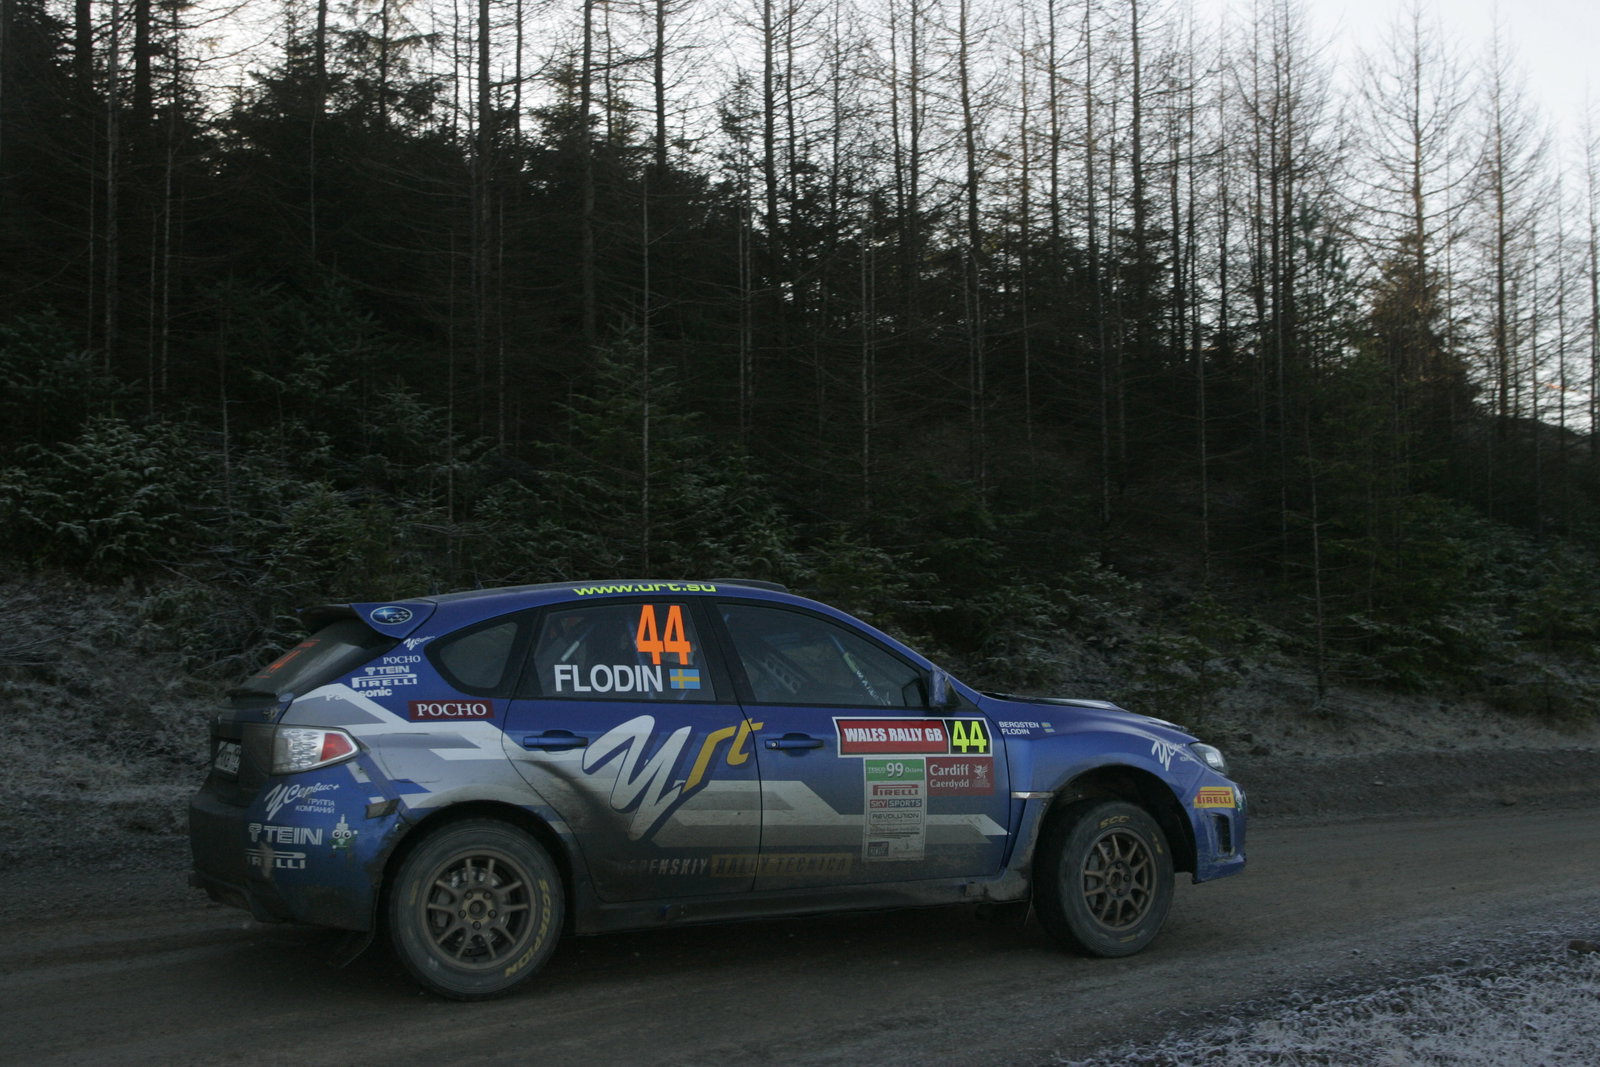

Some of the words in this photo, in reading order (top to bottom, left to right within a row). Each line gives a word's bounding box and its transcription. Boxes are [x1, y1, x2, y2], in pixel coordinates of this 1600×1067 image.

[573, 583, 718, 596] www.urt.su
[636, 604, 692, 666] 44
[352, 673, 418, 688] PIRELLI
[554, 664, 664, 692] FLODIN
[998, 721, 1040, 729] BERGSTEN
[844, 728, 886, 743] WALES
[888, 728, 924, 742] RALLY
[926, 728, 944, 742] GB
[952, 720, 988, 753] 44
[886, 762, 904, 778] 99
[929, 764, 970, 776] Cardiff
[873, 784, 919, 796] PIRELLI
[930, 779, 970, 791] Caerdydd
[870, 800, 887, 808] SKY
[888, 799, 922, 808] SPORTS
[1196, 790, 1233, 804] PIRELLI
